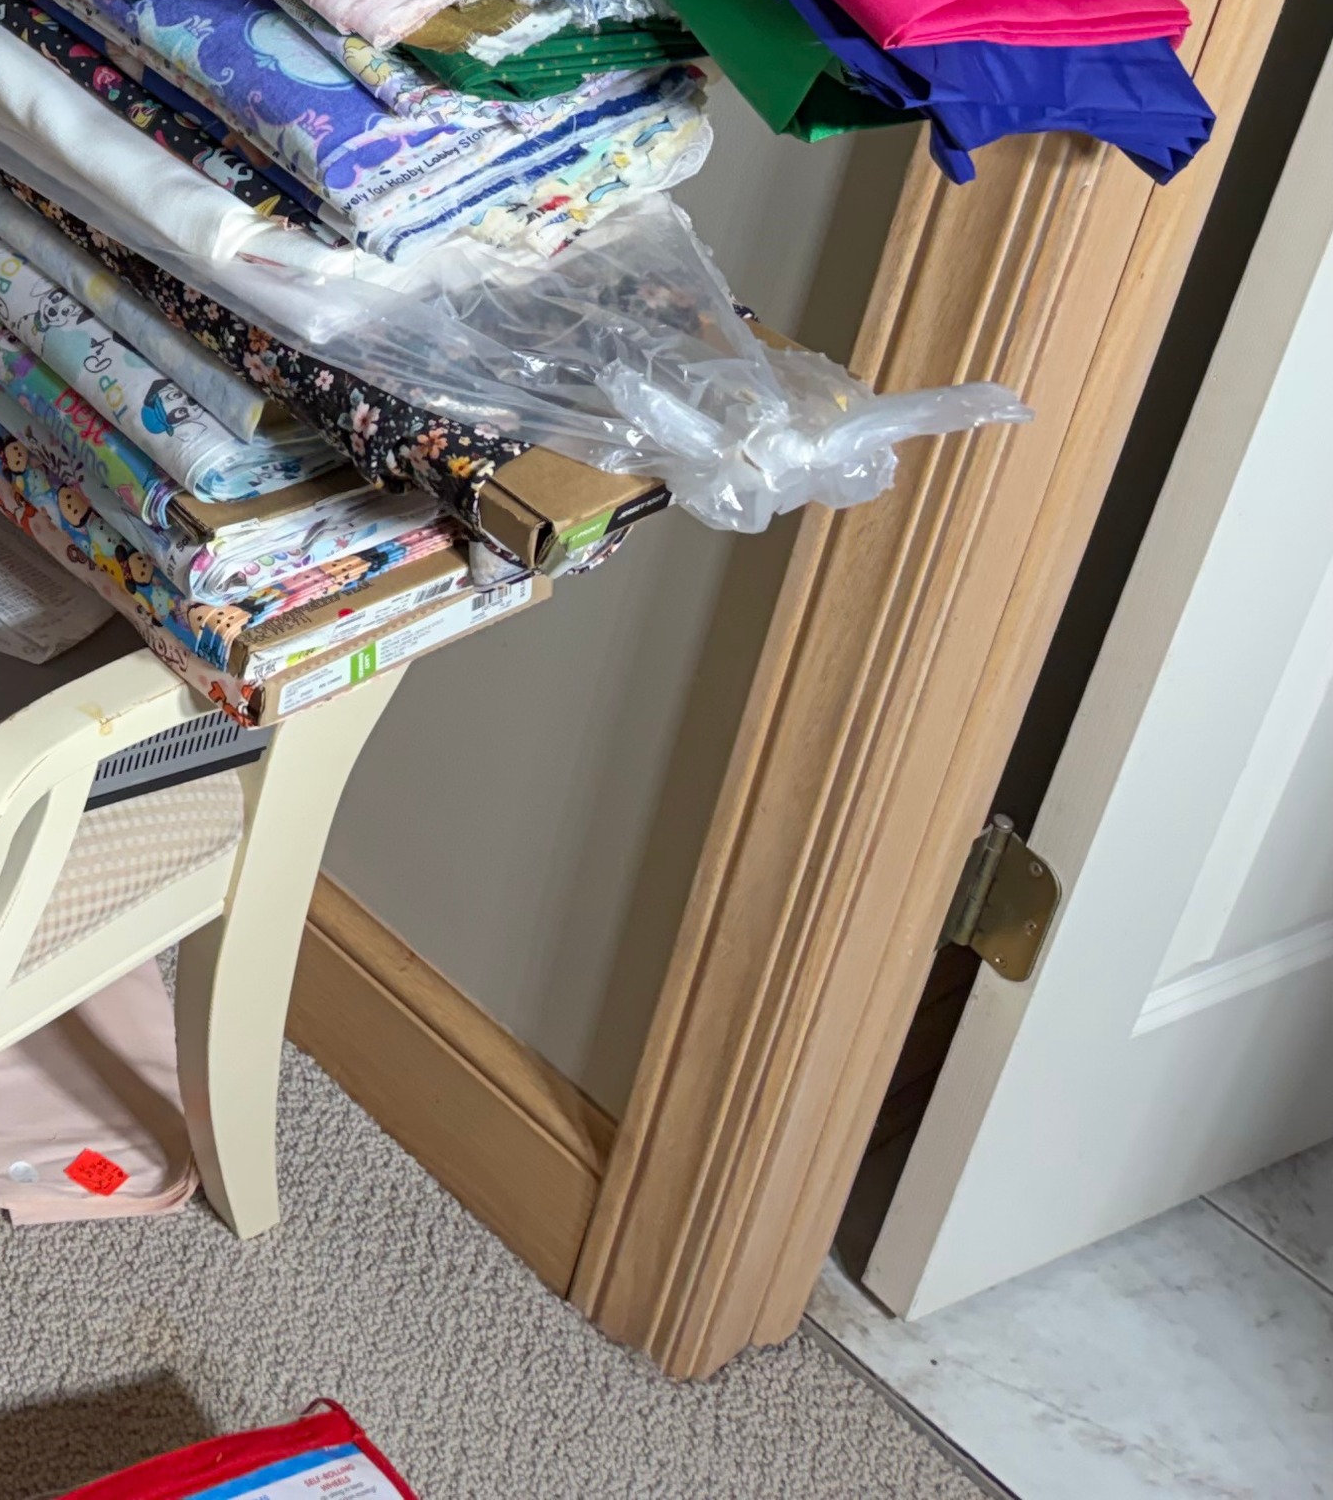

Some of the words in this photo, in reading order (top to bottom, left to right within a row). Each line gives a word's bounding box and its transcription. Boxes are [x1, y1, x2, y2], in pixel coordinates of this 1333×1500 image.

[387, 166, 424, 188] Hobby
[423, 145, 460, 168] Lobby
[98, 374, 129, 425] TOP
